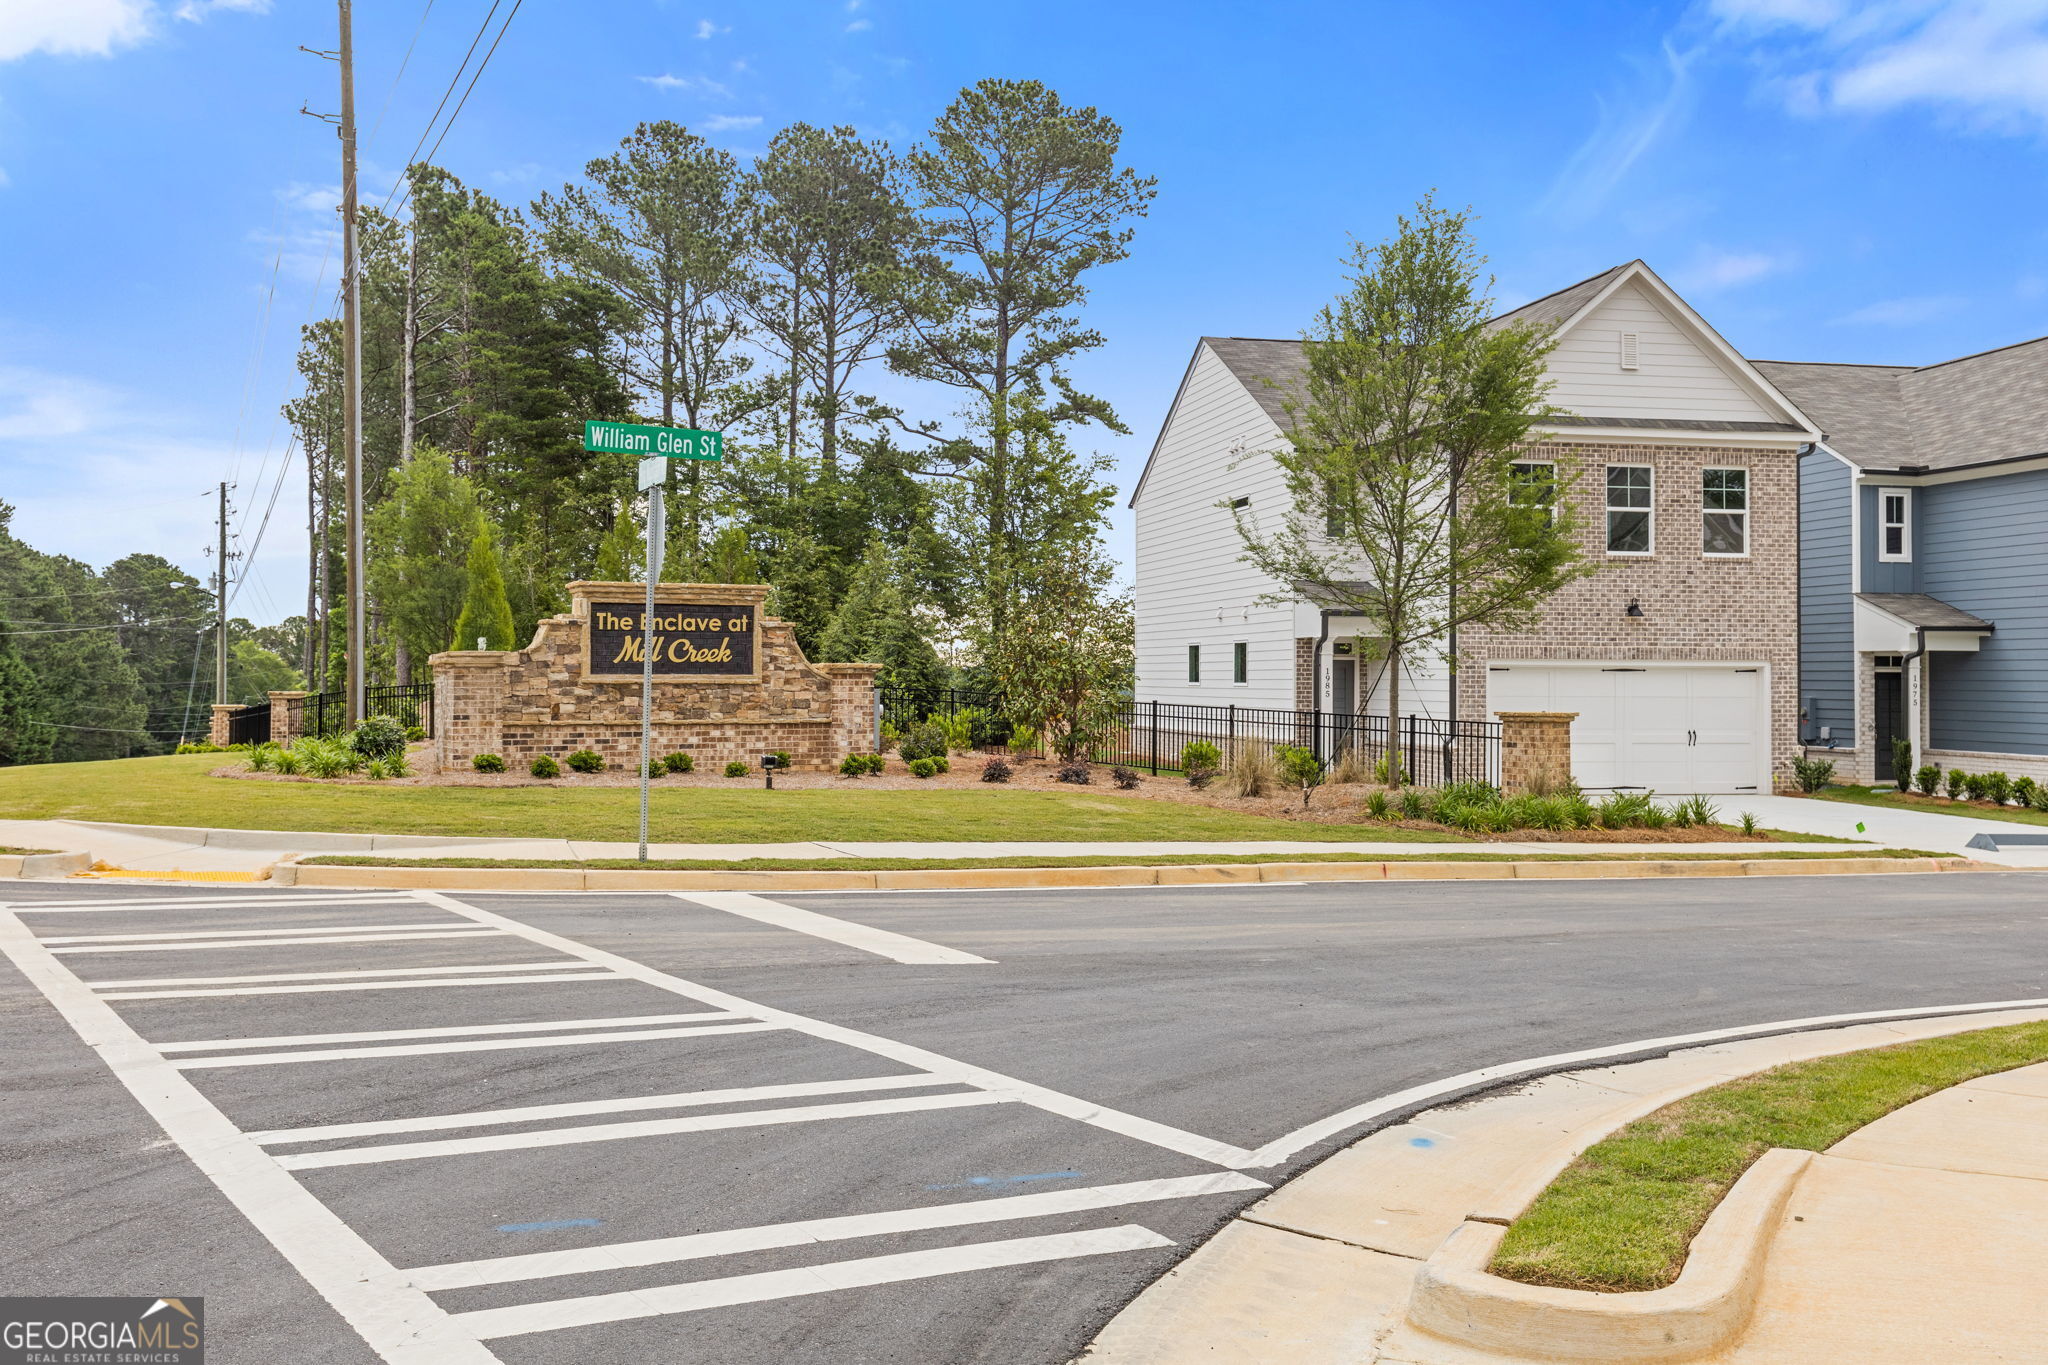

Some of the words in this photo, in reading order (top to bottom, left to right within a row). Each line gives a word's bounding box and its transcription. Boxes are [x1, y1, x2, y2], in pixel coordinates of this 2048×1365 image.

[591, 426, 650, 451] William
[657, 432, 693, 455] Glen
[700, 436, 717, 457] St
[596, 612, 634, 631] The
[728, 614, 748, 632] at
[667, 637, 733, 664] Creek
